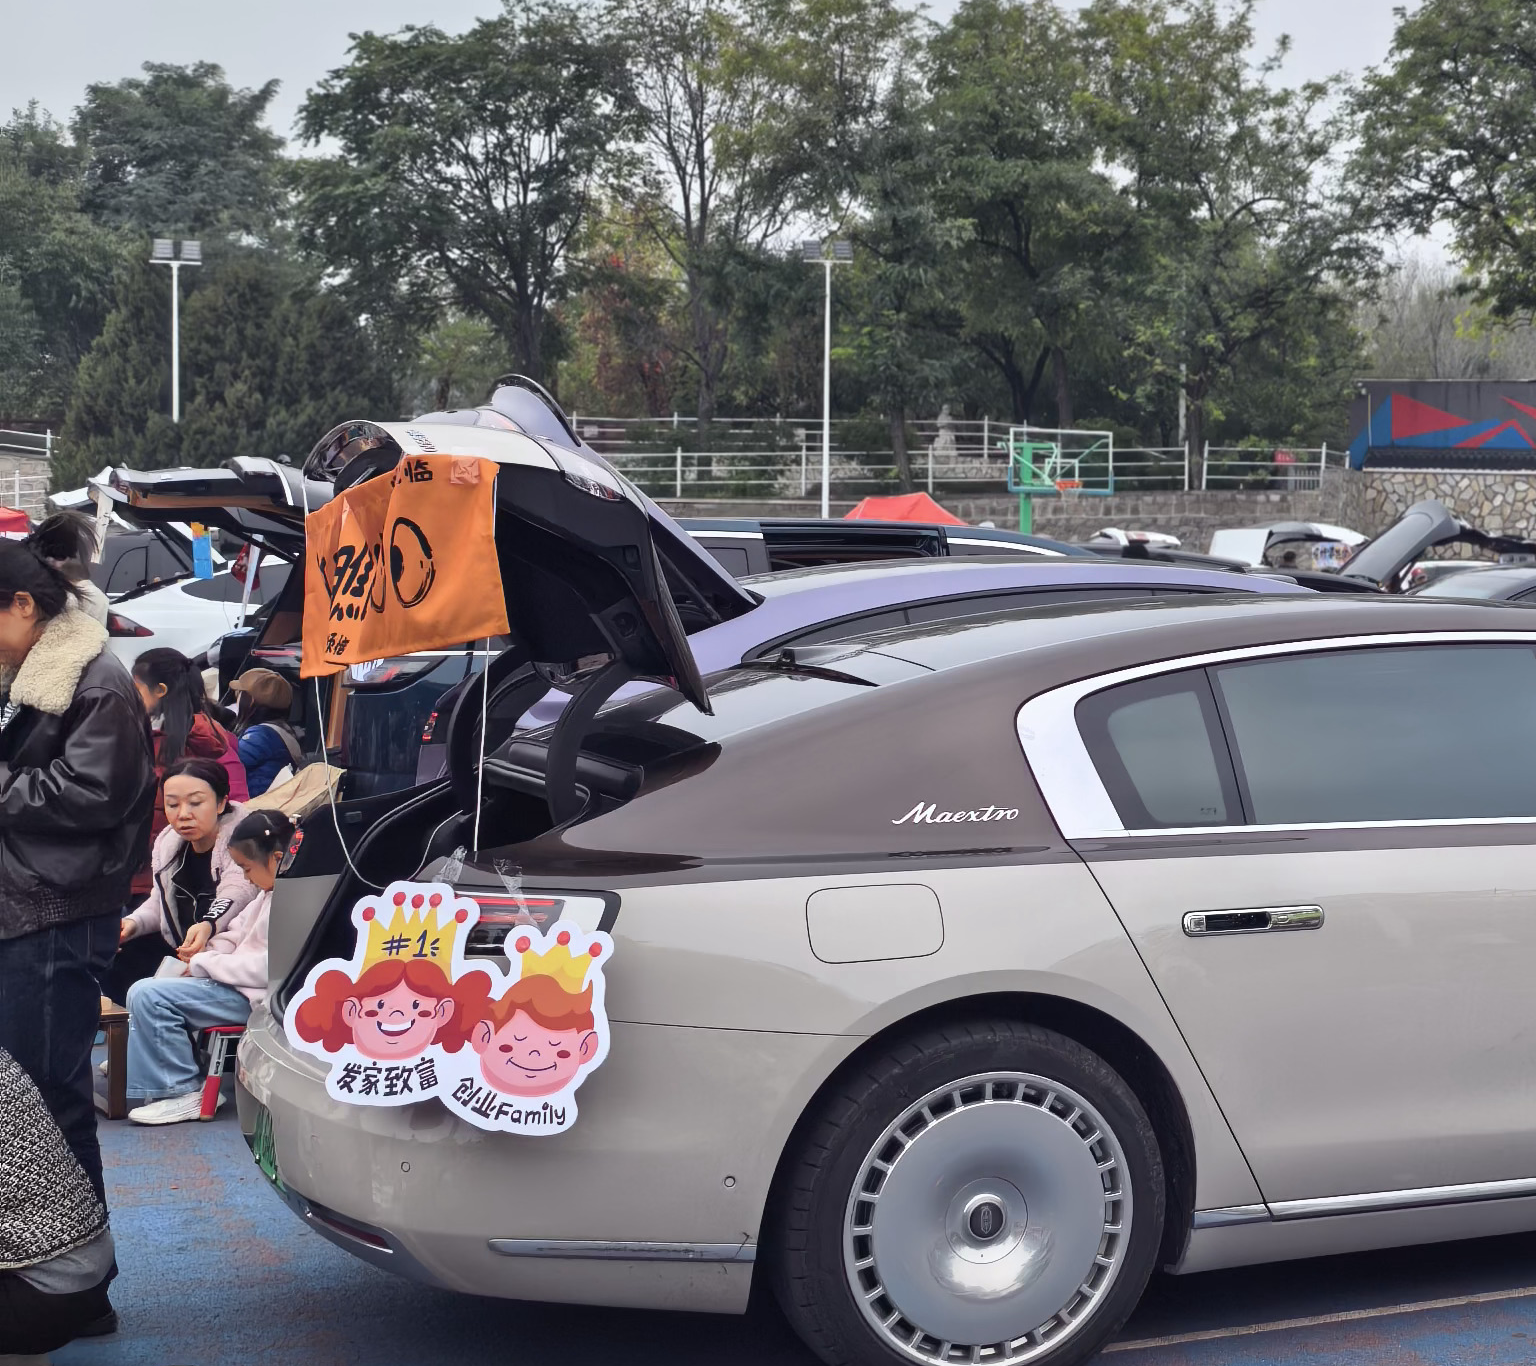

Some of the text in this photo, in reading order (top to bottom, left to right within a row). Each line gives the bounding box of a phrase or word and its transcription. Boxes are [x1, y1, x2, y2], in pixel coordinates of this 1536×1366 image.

[891, 800, 1020, 826] Maextro
[336, 1056, 439, 1097] 发家致富
